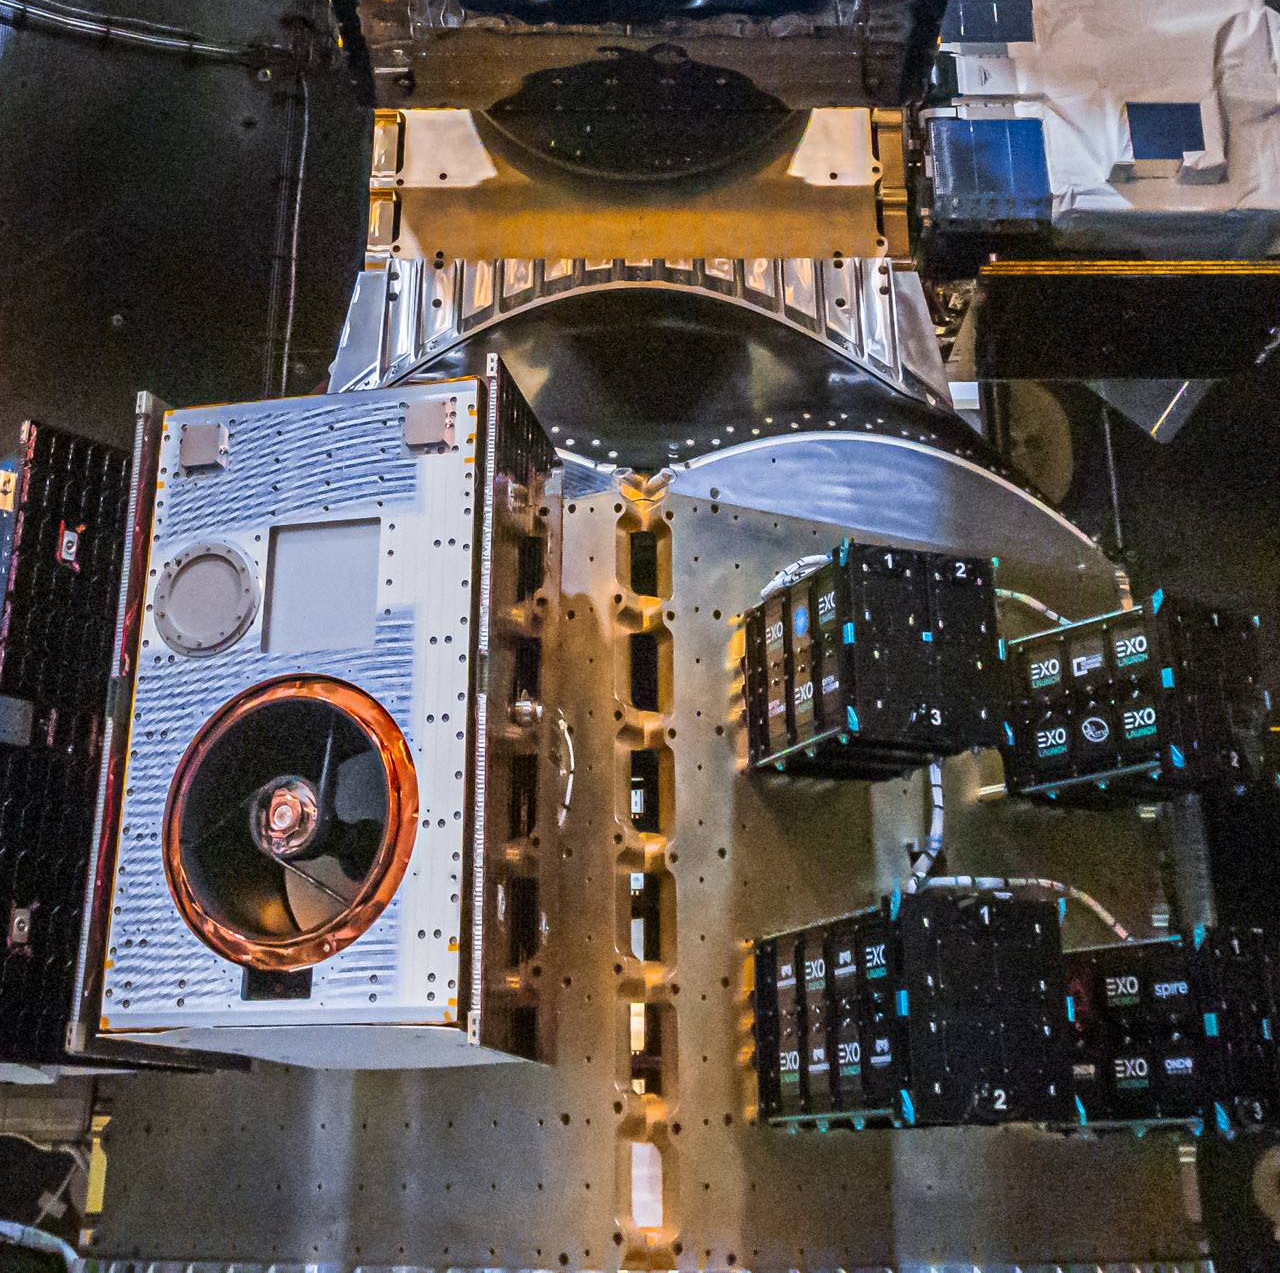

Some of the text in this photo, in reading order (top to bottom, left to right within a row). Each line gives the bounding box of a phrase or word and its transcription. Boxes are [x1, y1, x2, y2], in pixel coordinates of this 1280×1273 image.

[884, 553, 893, 569] 1
[955, 562, 967, 578] 2
[765, 621, 784, 644] EXO
[1116, 635, 1148, 658] EXO
[1030, 658, 1060, 680] EXO
[794, 681, 814, 705] EXO
[930, 709, 942, 726] 3
[1123, 707, 1156, 730] EXO
[1036, 727, 1067, 748] EXO
[980, 905, 990, 925] 1
[1232, 938, 1241, 955] 1
[804, 958, 826, 980] EXO
[1105, 976, 1139, 997] EXO
[1154, 981, 1188, 999] spire
[780, 1050, 800, 1071] EXO
[838, 1041, 861, 1064] EXO
[1114, 1058, 1148, 1078] EXO
[993, 1089, 1007, 1110] 2
